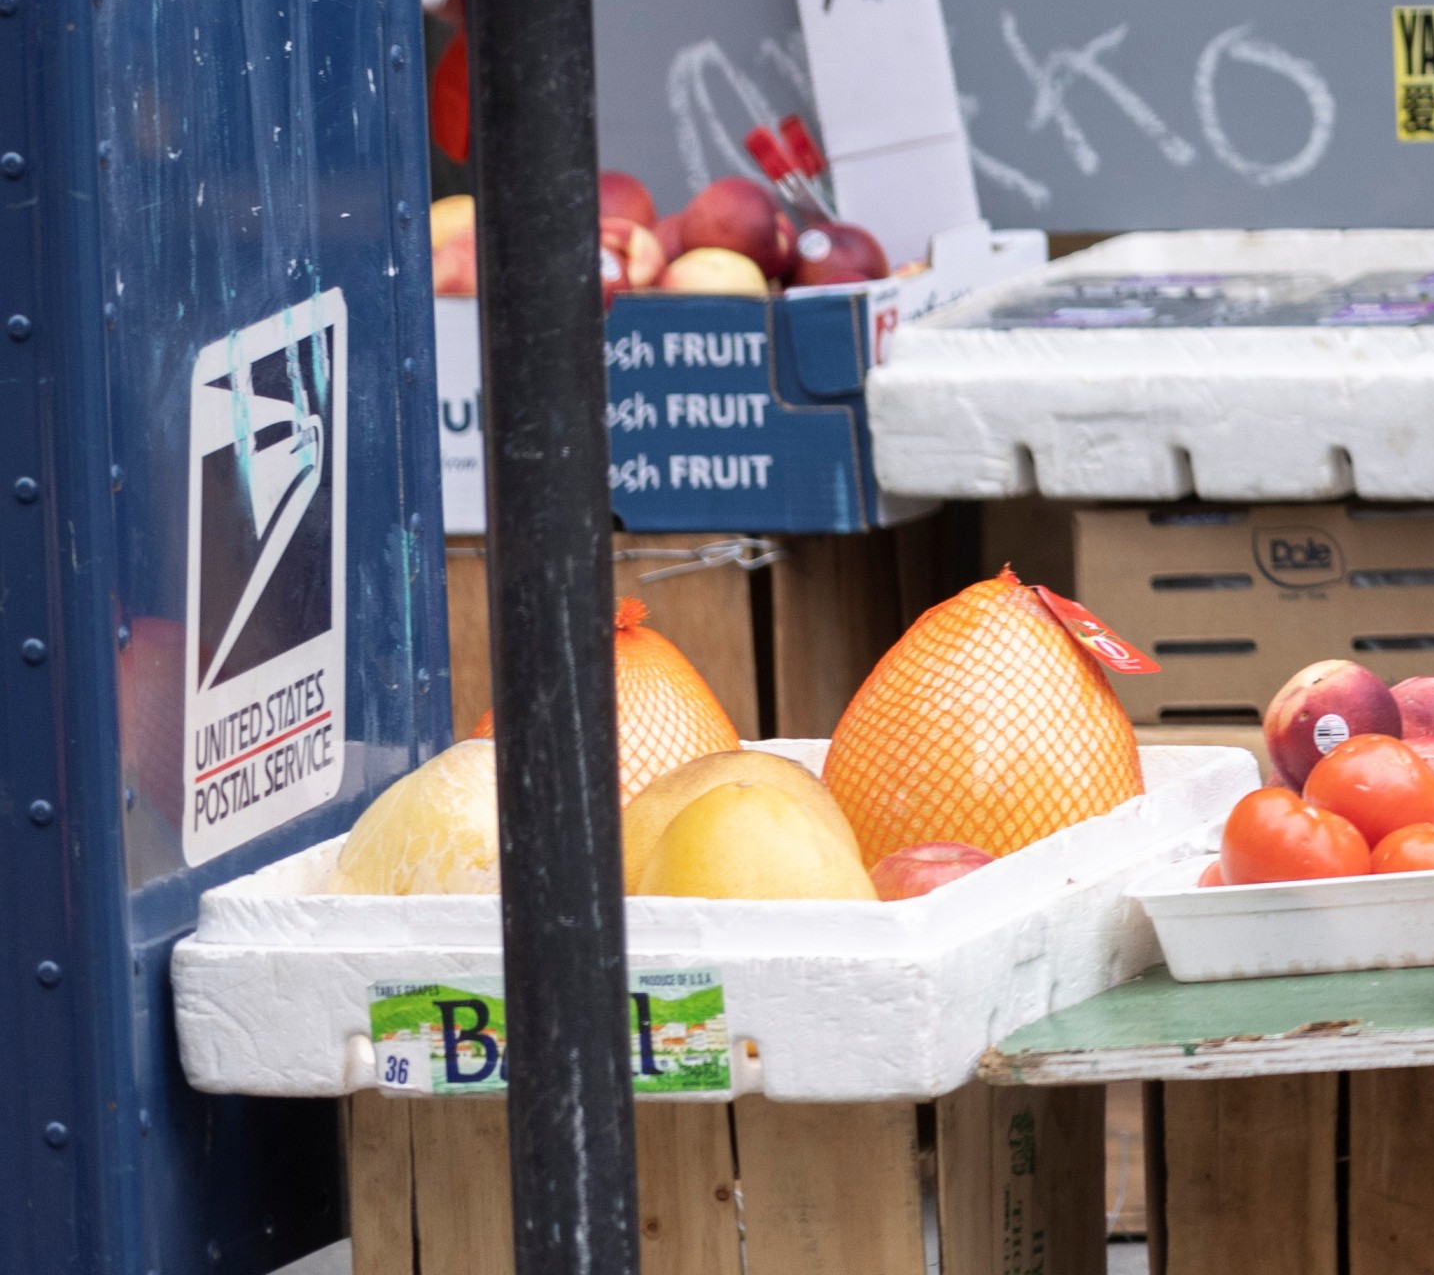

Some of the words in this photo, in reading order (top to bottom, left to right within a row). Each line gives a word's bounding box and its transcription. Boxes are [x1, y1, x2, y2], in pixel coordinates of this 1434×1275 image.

[662, 332, 768, 368] FRUIT
[666, 393, 770, 428] FRUIT
[668, 454, 773, 490] FRUIT
[195, 701, 262, 771] UNITED
[265, 668, 325, 738] STATES
[194, 762, 261, 833] POSTAL
[264, 723, 335, 798] SERVICE
[404, 984, 441, 997] GRAPES
[384, 1055, 410, 1084] 36
